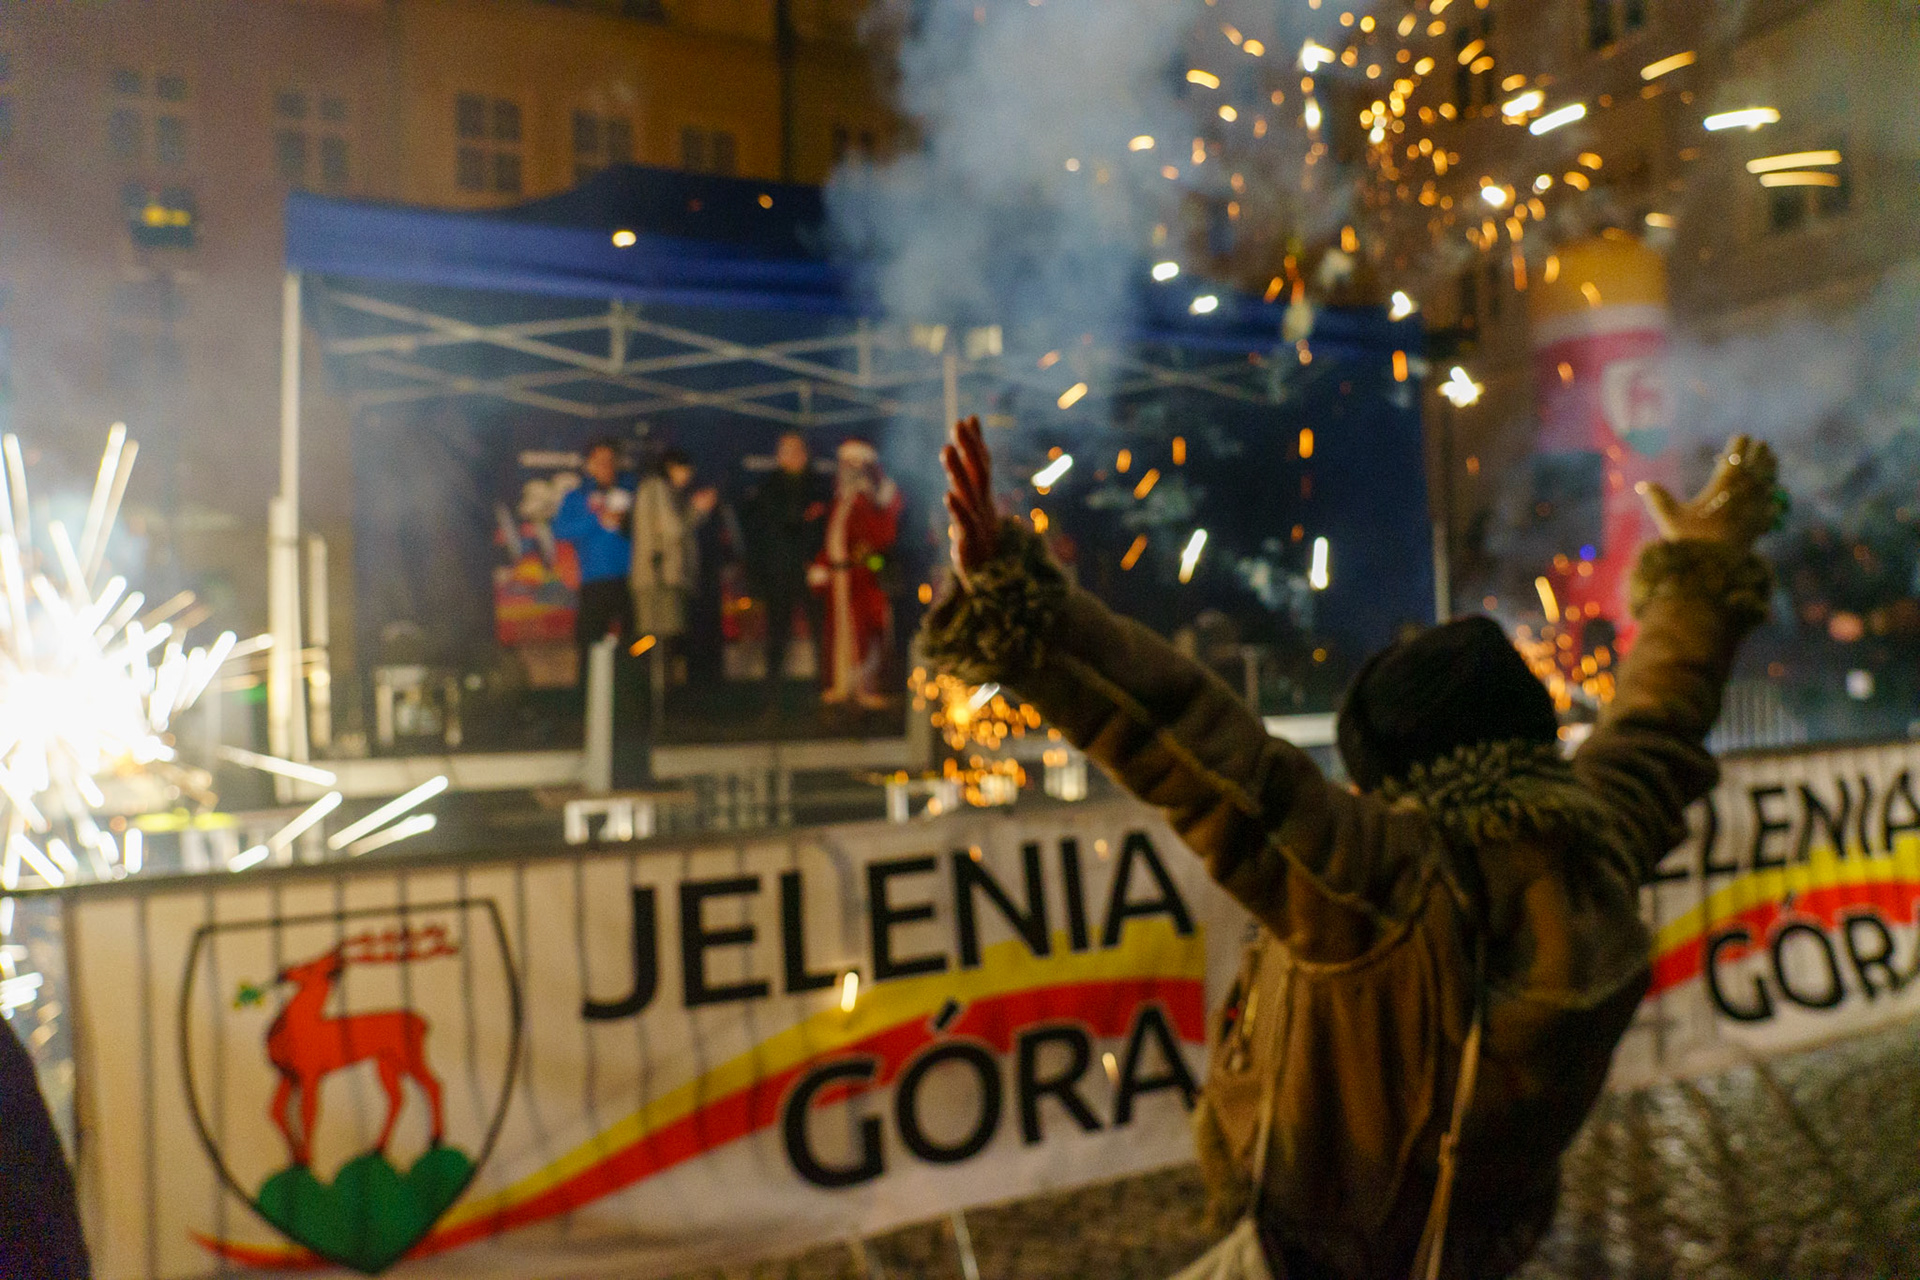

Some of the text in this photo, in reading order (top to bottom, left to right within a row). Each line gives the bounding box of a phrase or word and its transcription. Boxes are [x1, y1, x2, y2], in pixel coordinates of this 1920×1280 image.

[1653, 771, 1920, 881] LENIA
[582, 829, 1195, 1020] JELENIA
[783, 997, 1198, 1187] GÓRA
